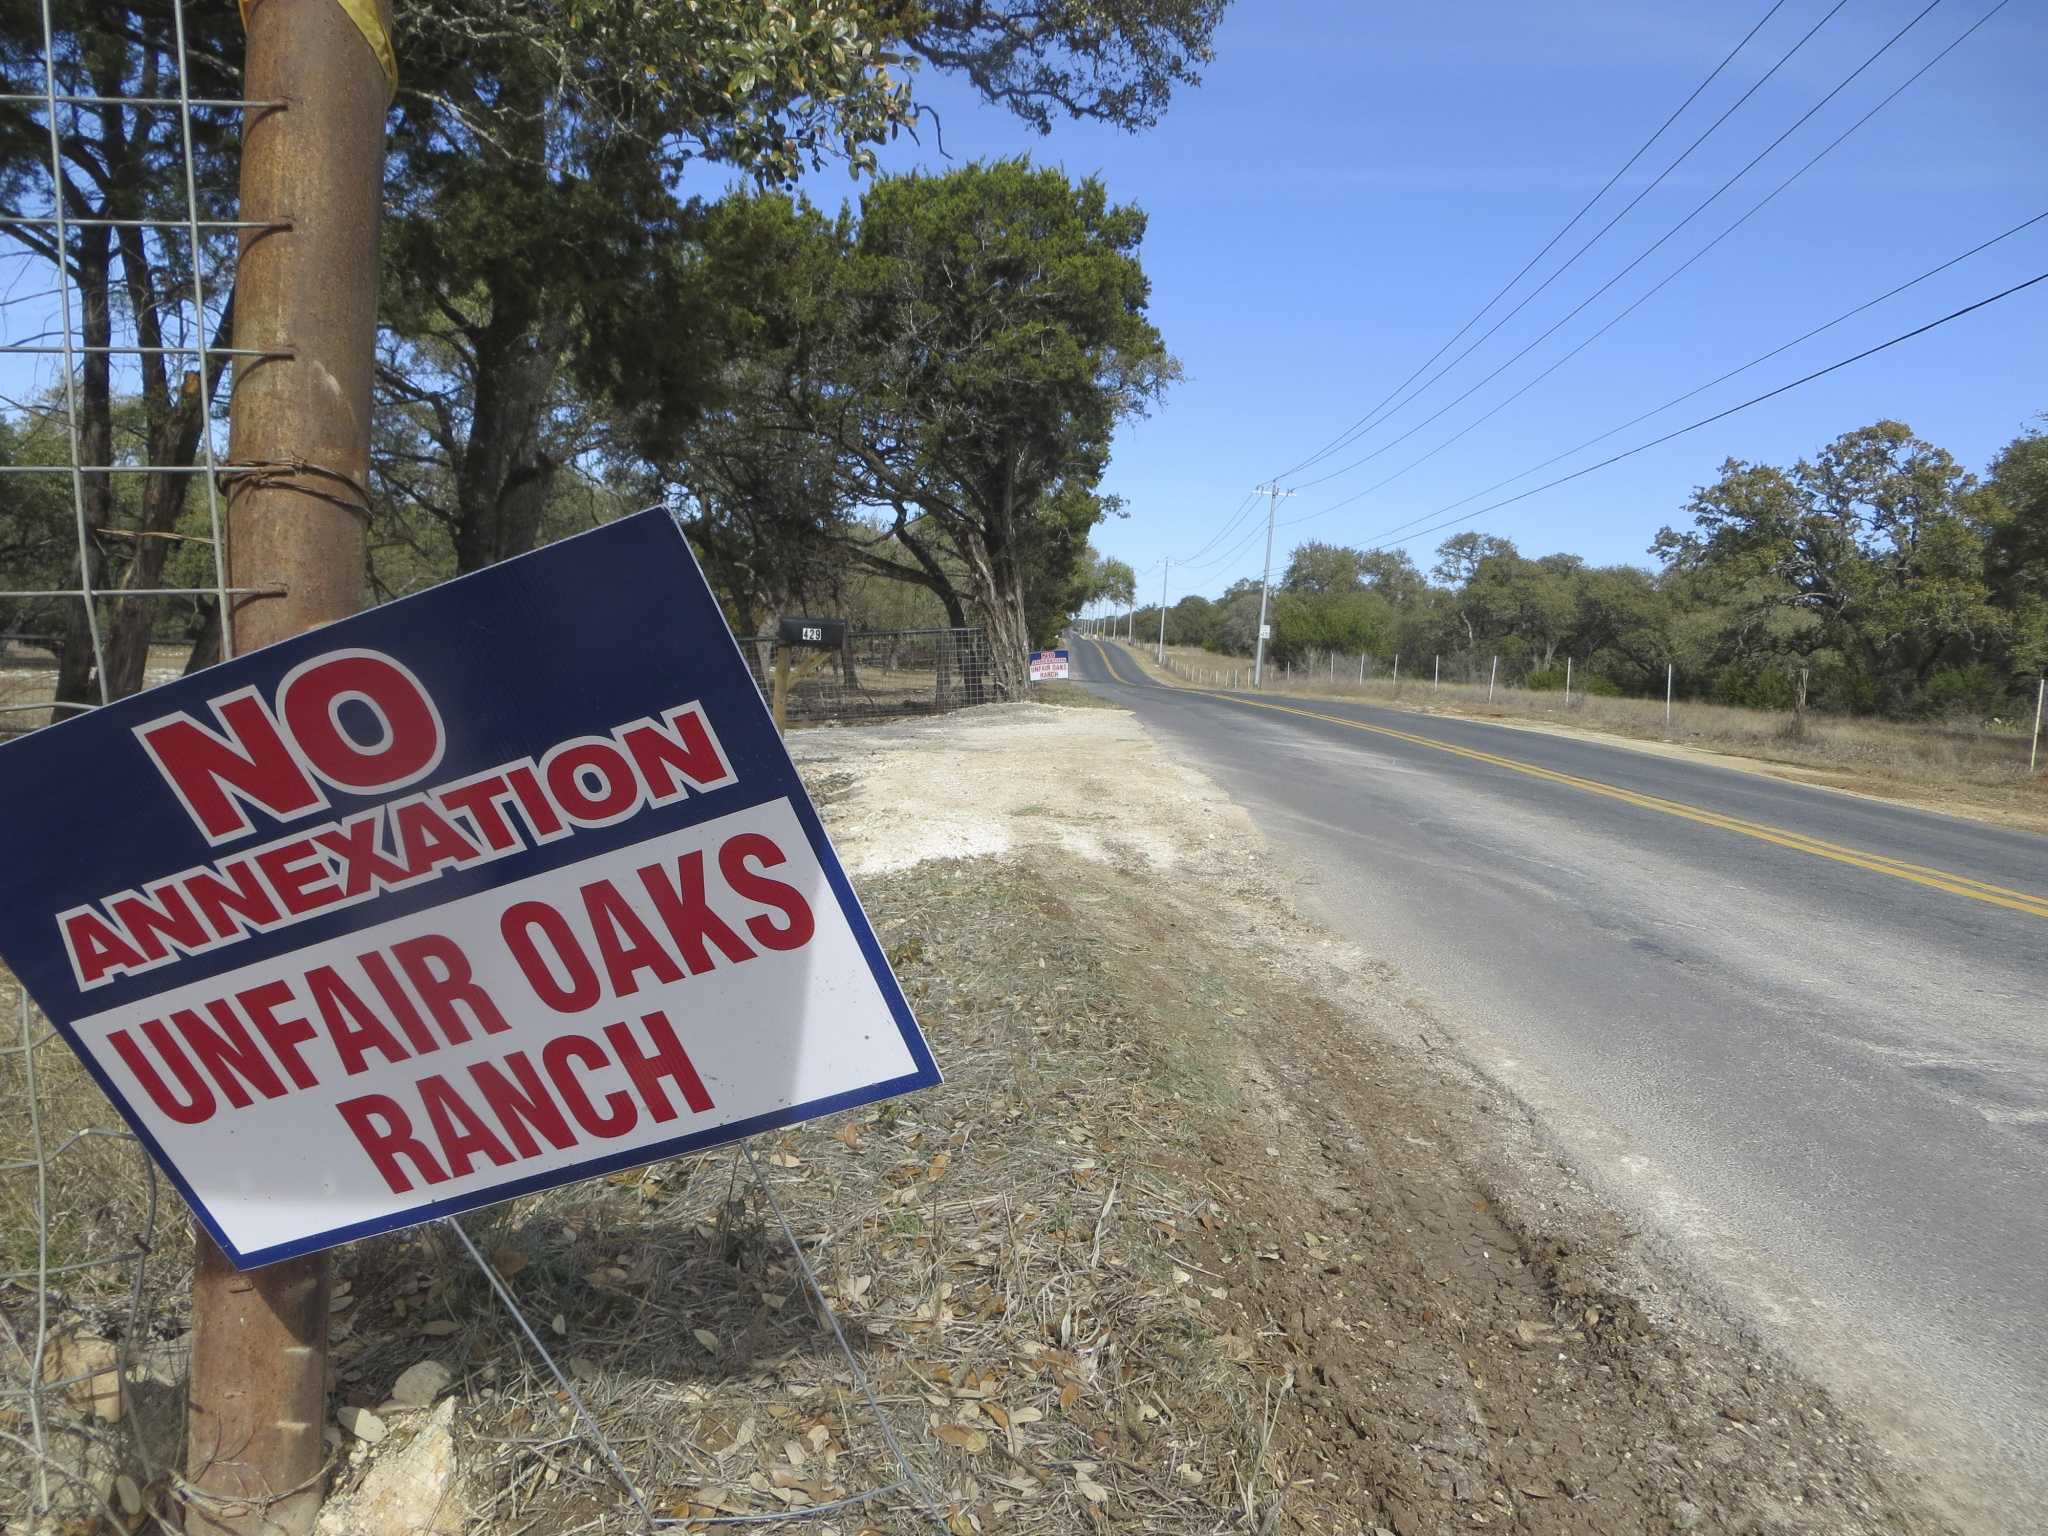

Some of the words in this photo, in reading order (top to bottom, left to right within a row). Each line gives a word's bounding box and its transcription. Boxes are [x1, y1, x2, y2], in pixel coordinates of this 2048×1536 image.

[803, 628, 821, 640] 429
[55, 700, 739, 992] ANNEXATION
[131, 648, 446, 847] NO
[106, 933, 508, 1125] UNFAIR
[500, 833, 815, 1015] OAKS
[336, 1011, 716, 1195] RANCH
